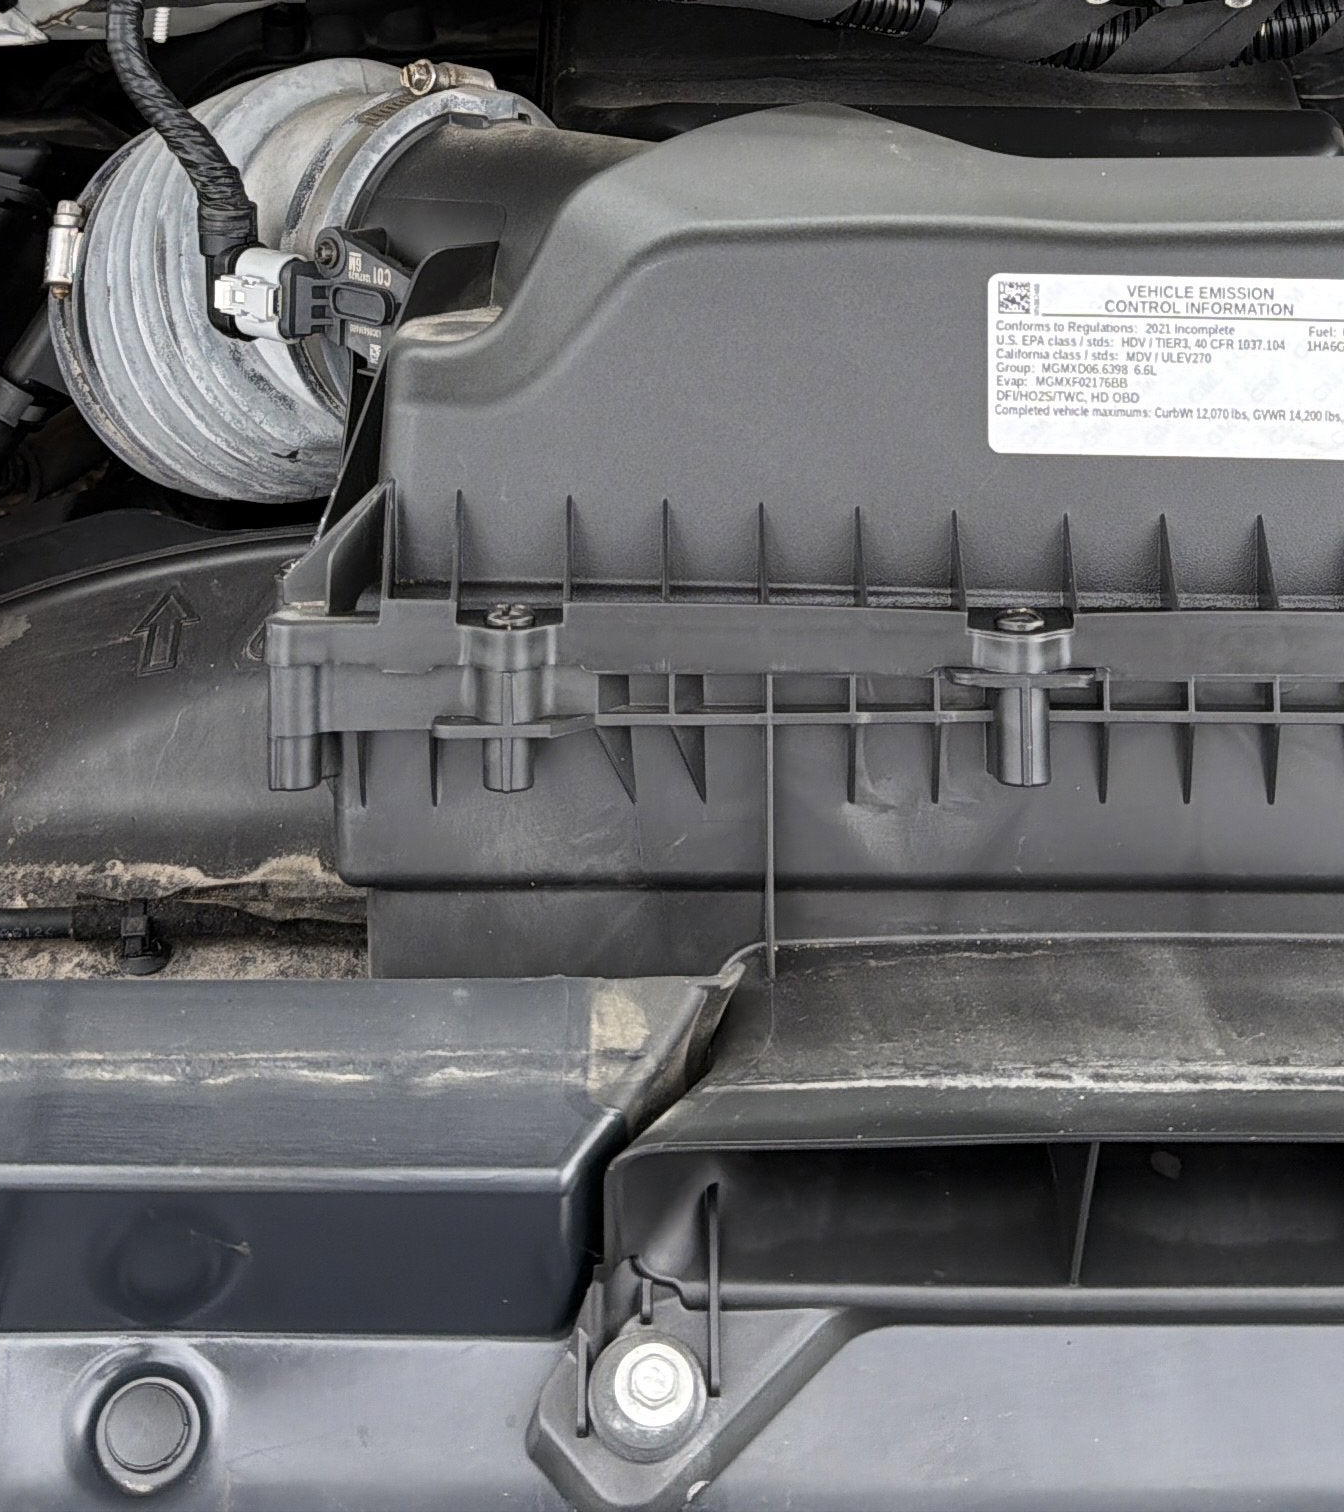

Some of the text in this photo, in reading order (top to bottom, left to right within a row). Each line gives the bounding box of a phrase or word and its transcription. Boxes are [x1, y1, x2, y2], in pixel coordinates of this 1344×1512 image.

[1127, 285, 1275, 300] VEHICLE EMISSION
[1105, 299, 1294, 316] CONTROL INFORMATION
[995, 320, 1236, 337] Conforms to Regulations: 2021 Incomplete
[1308, 326, 1337, 337] Fuel:
[996, 335, 1018, 346] U.S.
[1022, 335, 1045, 346] EPA
[1048, 335, 1077, 347] class
[1086, 336, 1114, 348] stds:
[1121, 337, 1146, 348] HDV
[1194, 338, 1207, 349] 40
[1210, 339, 1234, 350] CFR
[1238, 339, 1286, 351] 1037.104
[995, 348, 1050, 360] California
[1052, 349, 1081, 361] class
[1091, 350, 1119, 361] stds:
[1126, 351, 1152, 362] MDV
[1161, 352, 1212, 364] ULEV270
[995, 362, 1035, 375] Group:
[996, 375, 1028, 388] Evap:
[1091, 392, 1109, 403] HD
[1112, 392, 1140, 404] OBD
[994, 404, 1050, 418] Completed
[1053, 405, 1089, 417] vehicle
[1092, 407, 1152, 418] maximums:
[1155, 407, 1194, 419] CurbWt
[1196, 408, 1229, 421] 12,070
[1253, 409, 1286, 421] GVWR
[1289, 410, 1322, 422] 14,200
